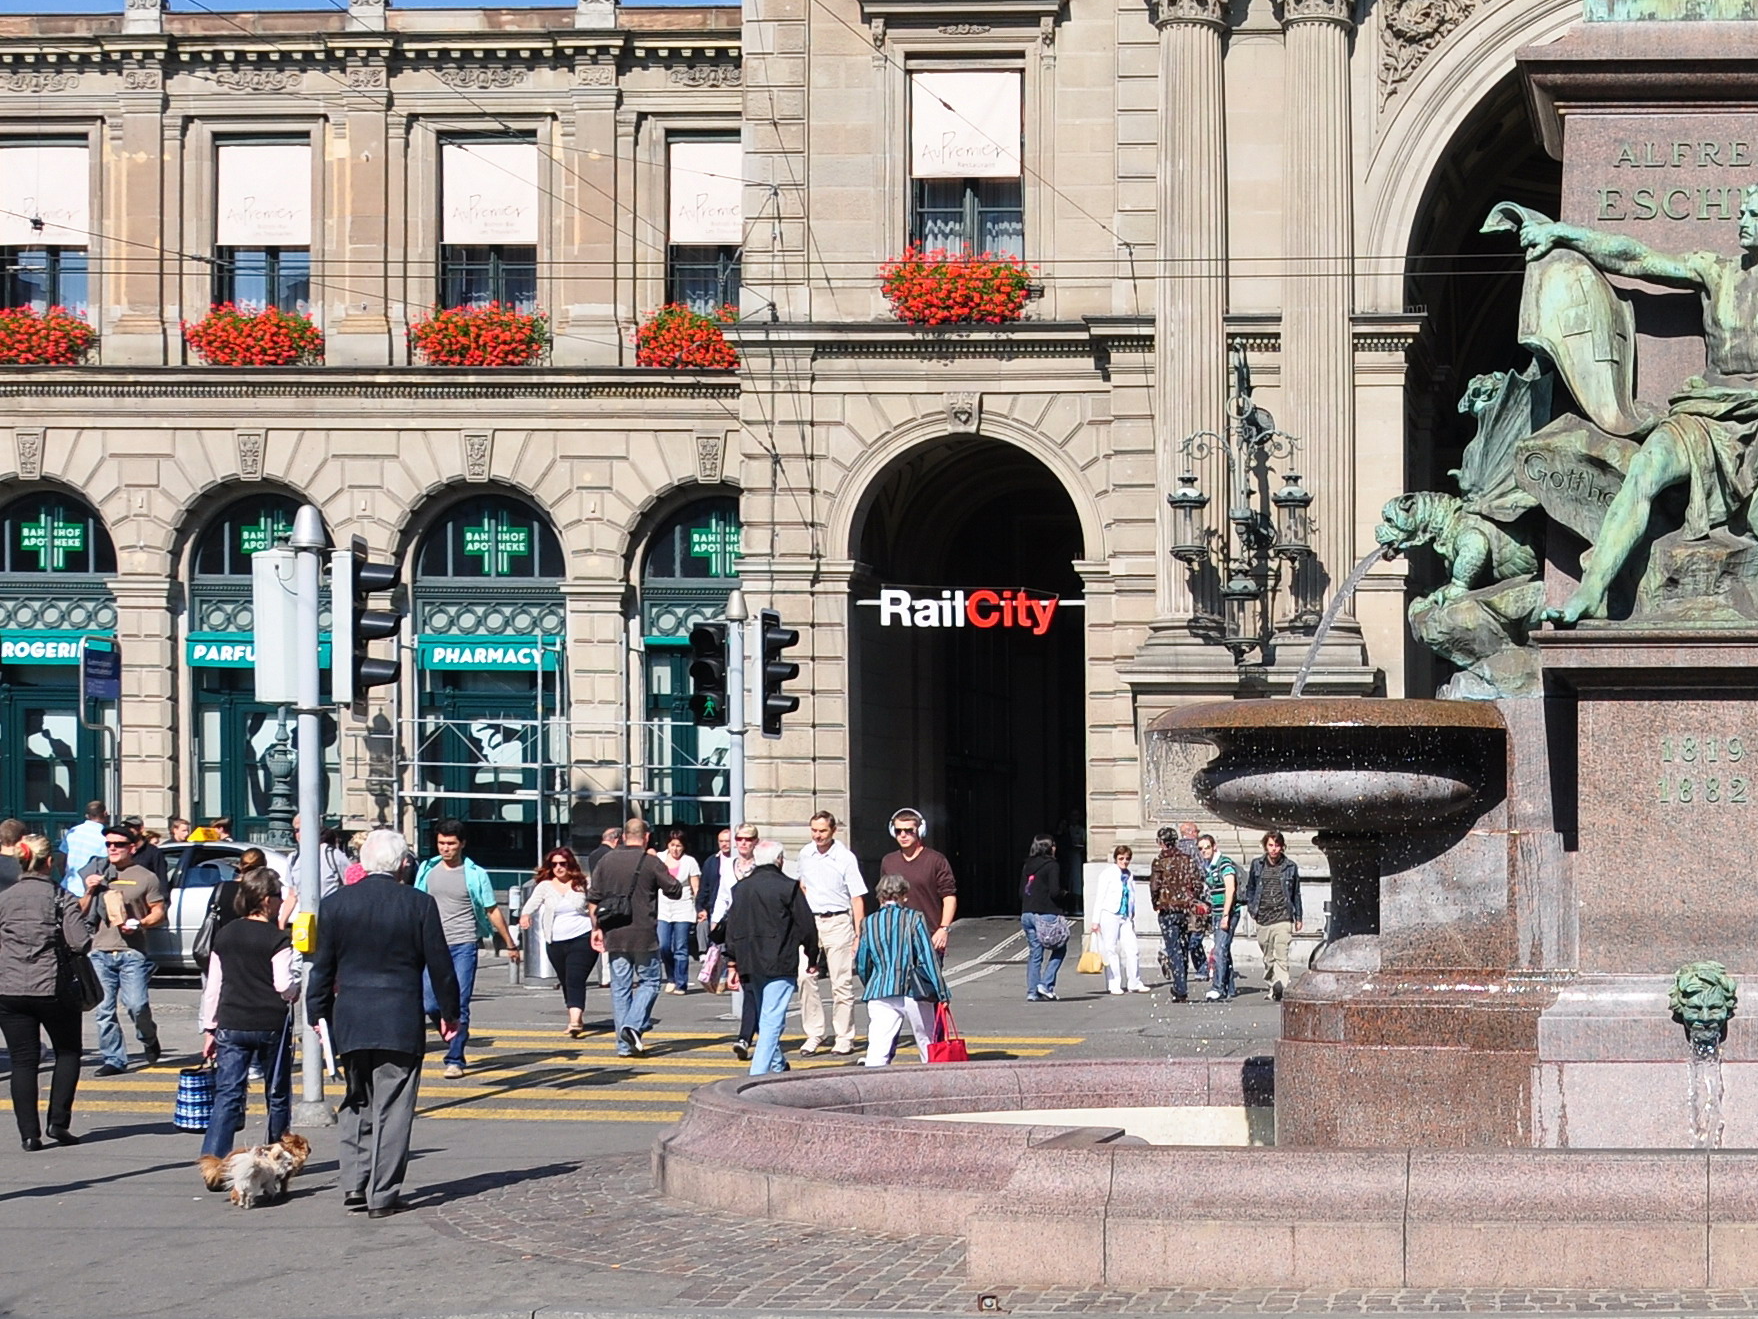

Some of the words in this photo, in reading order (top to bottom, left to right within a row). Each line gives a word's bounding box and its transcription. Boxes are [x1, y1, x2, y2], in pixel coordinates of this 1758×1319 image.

[1597, 185, 1754, 222] ESCH
[880, 589, 1058, 635] RailCity
[194, 645, 256, 661] PARFU
[433, 647, 544, 664] PHARMACY
[1660, 735, 1744, 763] 1819
[1658, 777, 1747, 803] 1882
